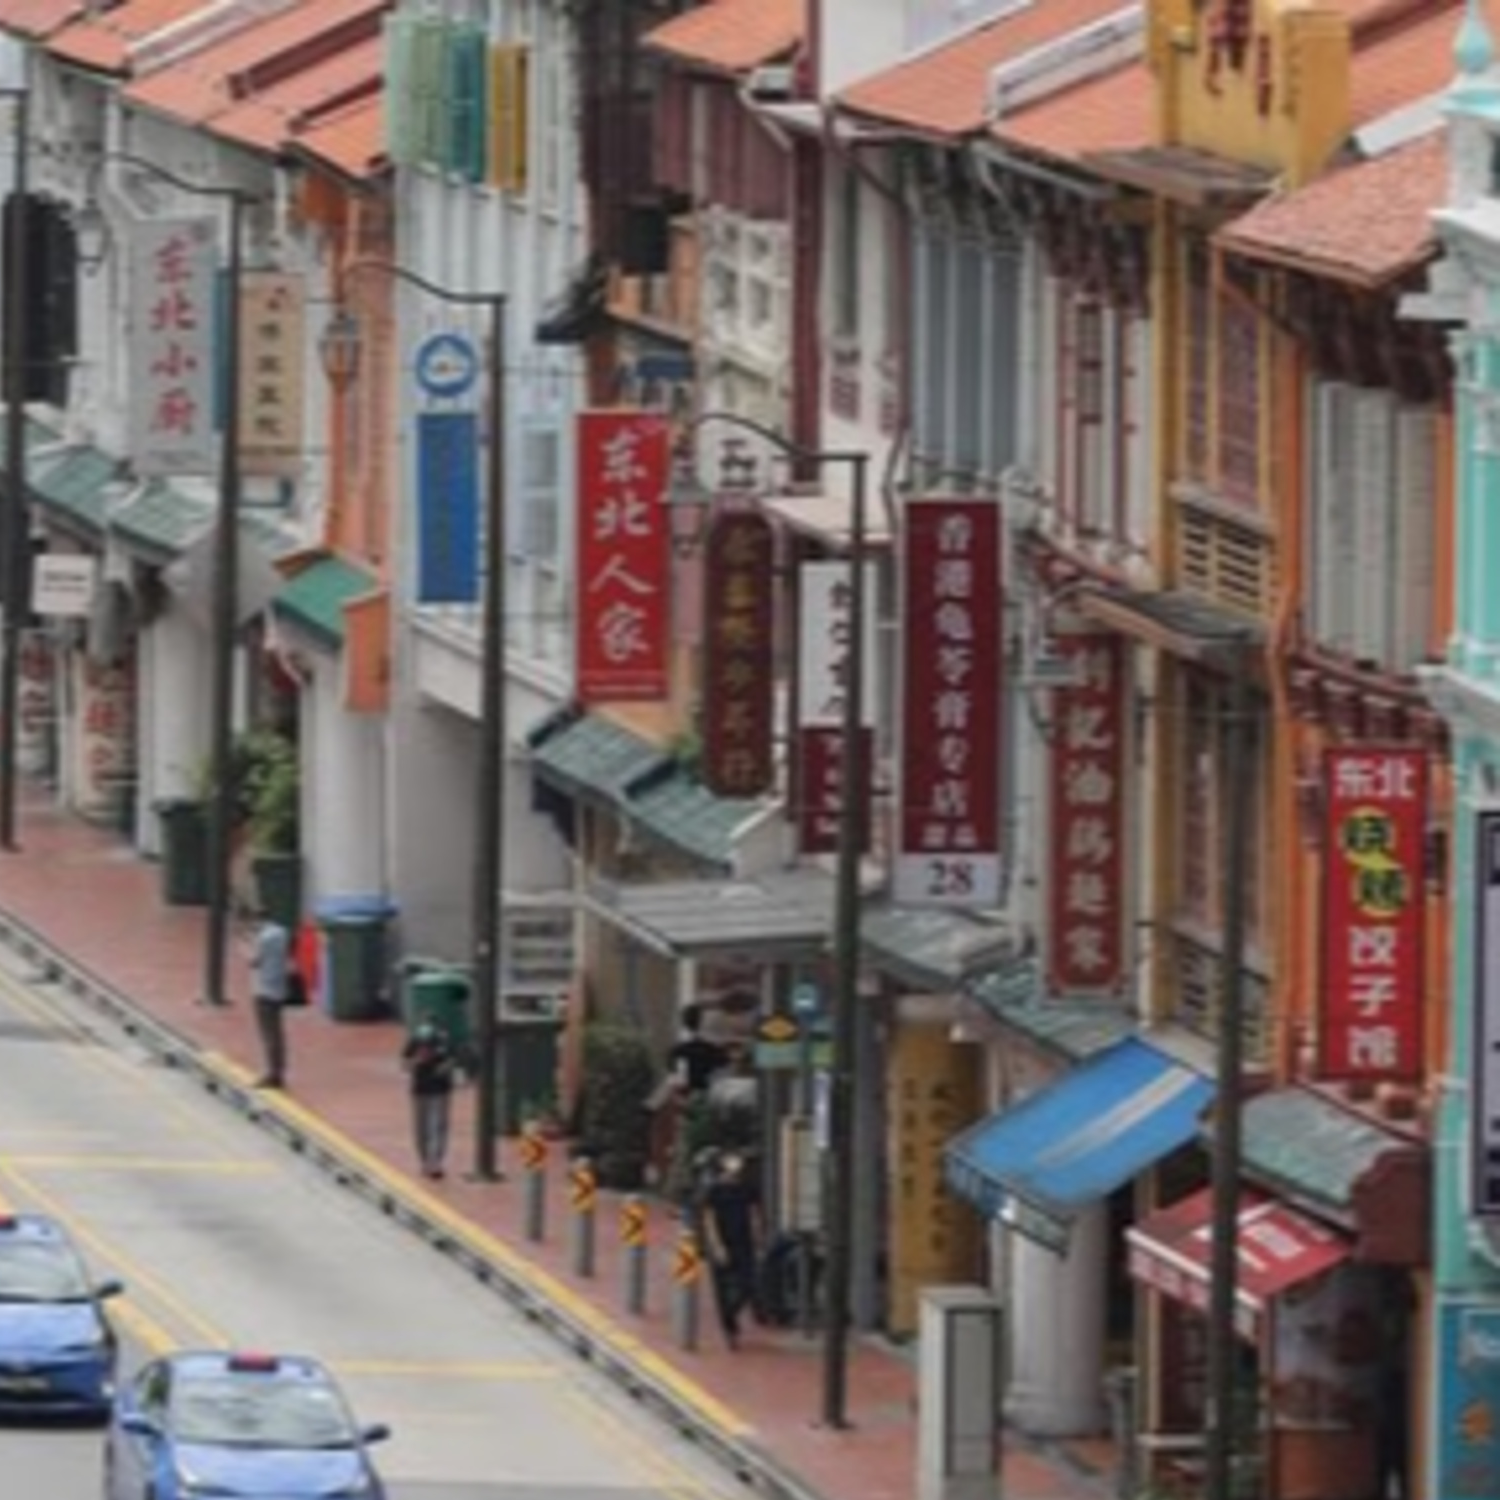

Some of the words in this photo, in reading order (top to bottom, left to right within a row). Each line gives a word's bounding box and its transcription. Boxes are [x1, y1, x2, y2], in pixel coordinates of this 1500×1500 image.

[588, 424, 656, 664] 东北人家
[927, 857, 974, 897] 28
